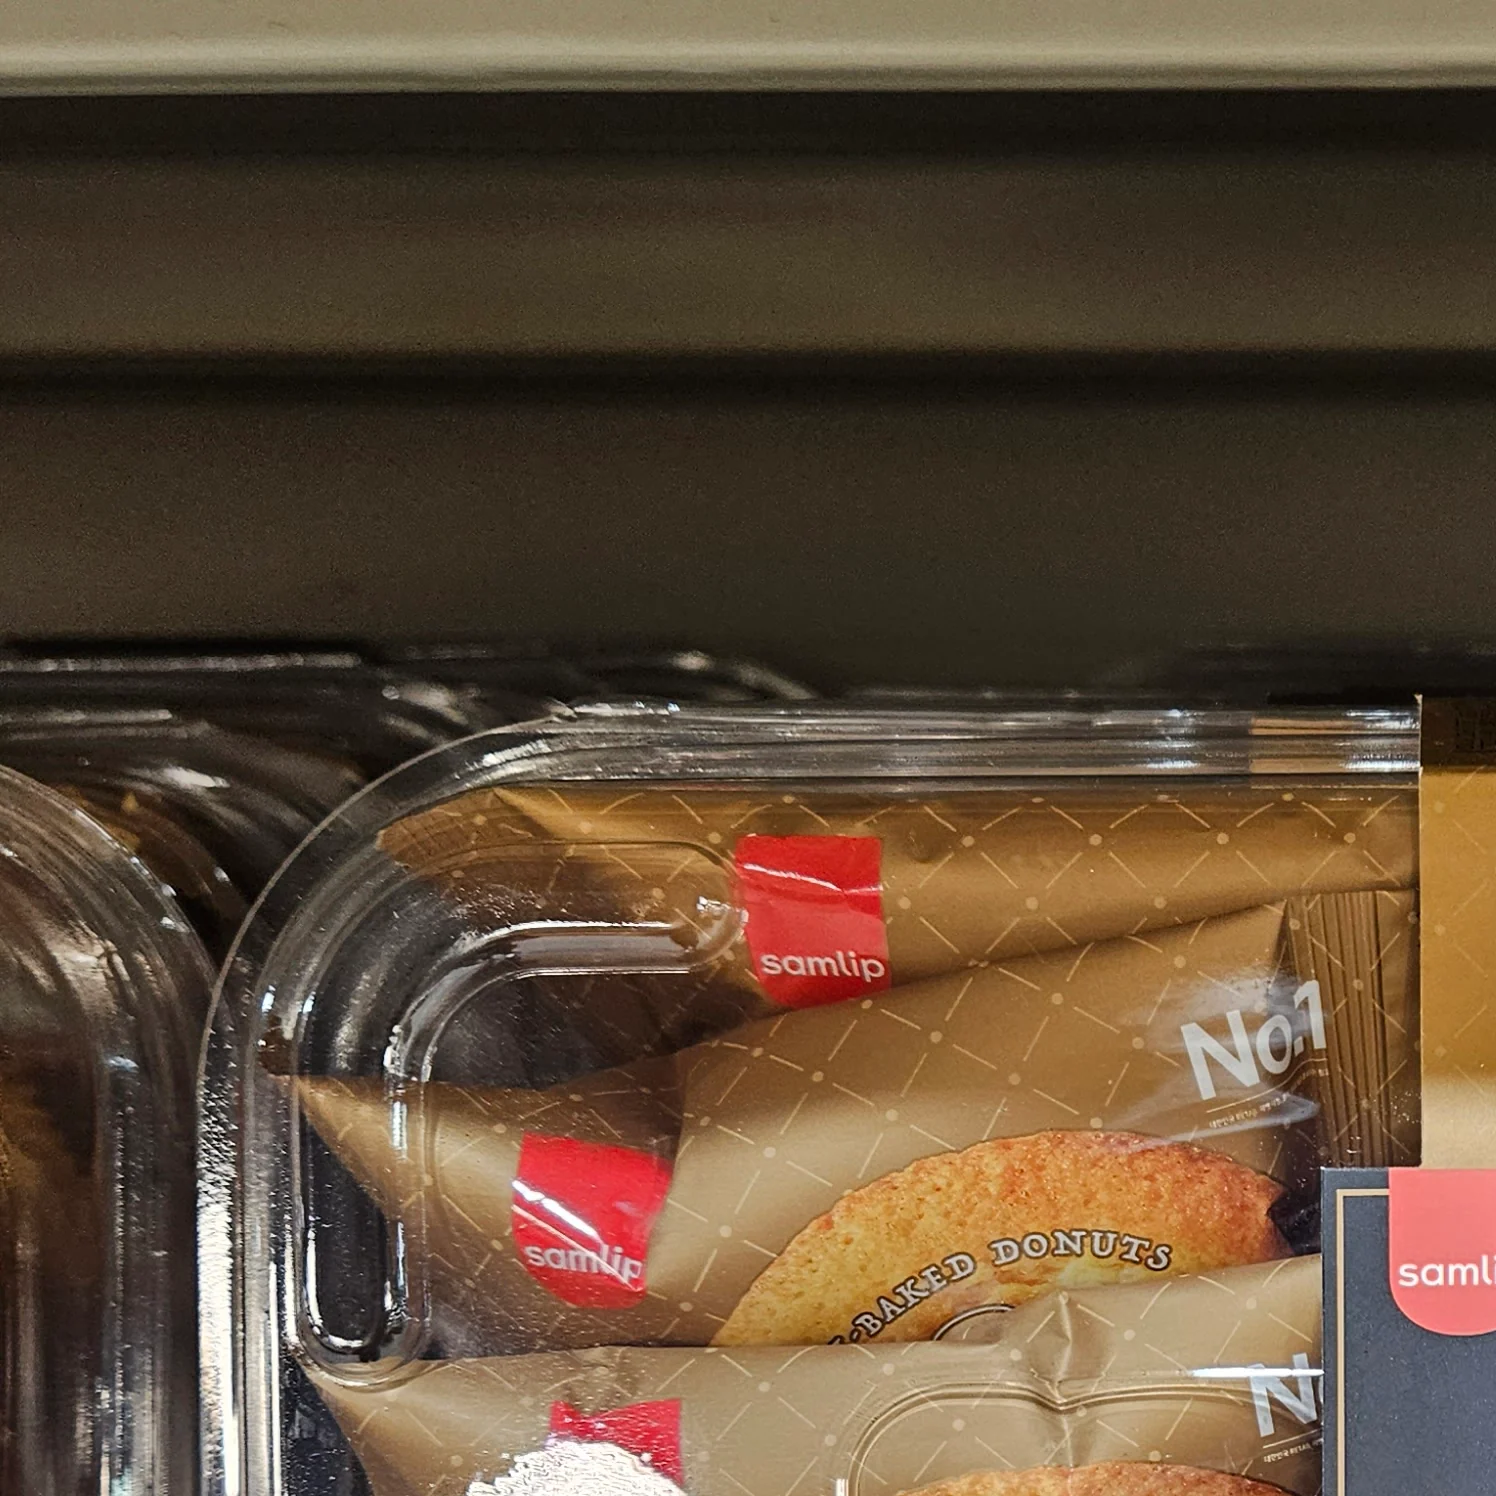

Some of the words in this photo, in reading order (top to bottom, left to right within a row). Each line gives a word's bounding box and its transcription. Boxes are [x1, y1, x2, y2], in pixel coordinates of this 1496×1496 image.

[760, 950, 885, 983] samlip
[1180, 979, 1327, 1101] No.1
[524, 1243, 644, 1285] samlip
[990, 1229, 1173, 1271] DONUTS
